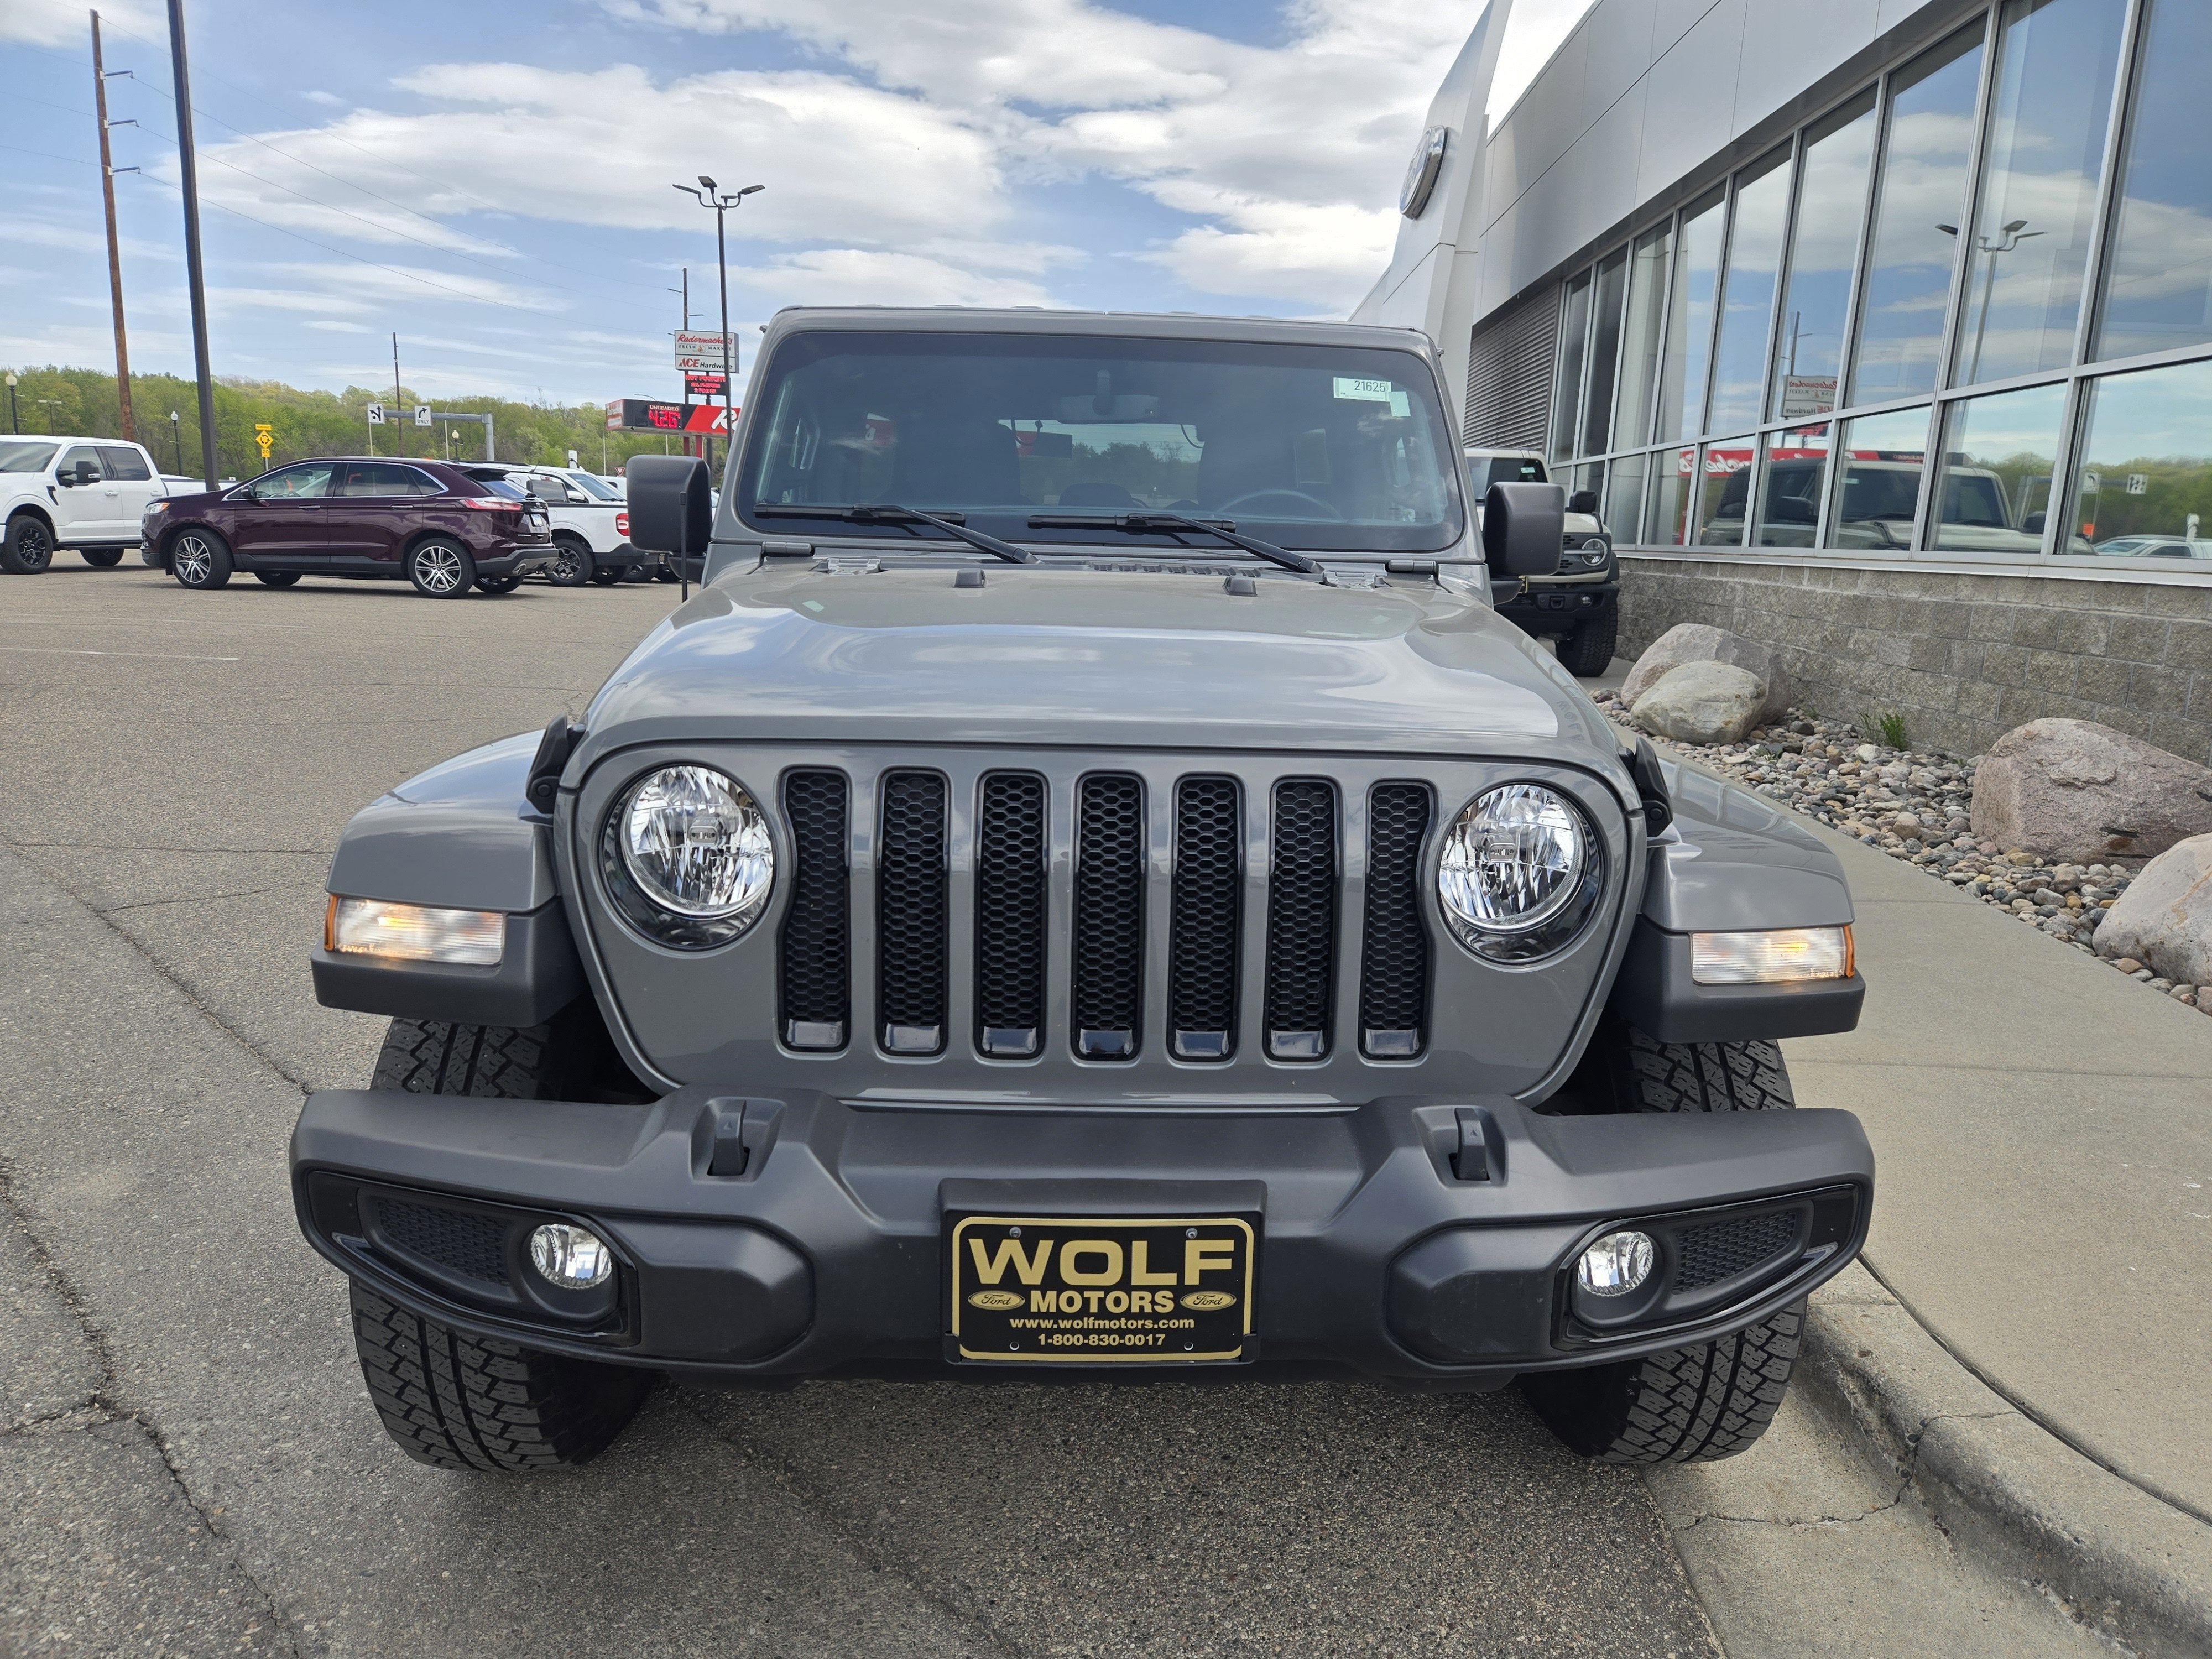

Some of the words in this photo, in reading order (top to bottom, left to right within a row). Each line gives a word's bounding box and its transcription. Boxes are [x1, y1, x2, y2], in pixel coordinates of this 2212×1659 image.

[677, 334, 733, 344] Radermache's
[679, 357, 700, 367] ACE
[1354, 380, 1386, 392] 21625
[969, 1239, 1234, 1286] WOLF
[1031, 1291, 1174, 1313] MOTORS
[1010, 1317, 1194, 1329] www.wolfmotors.com
[1039, 1334, 1165, 1345] 1-800-830-0017
